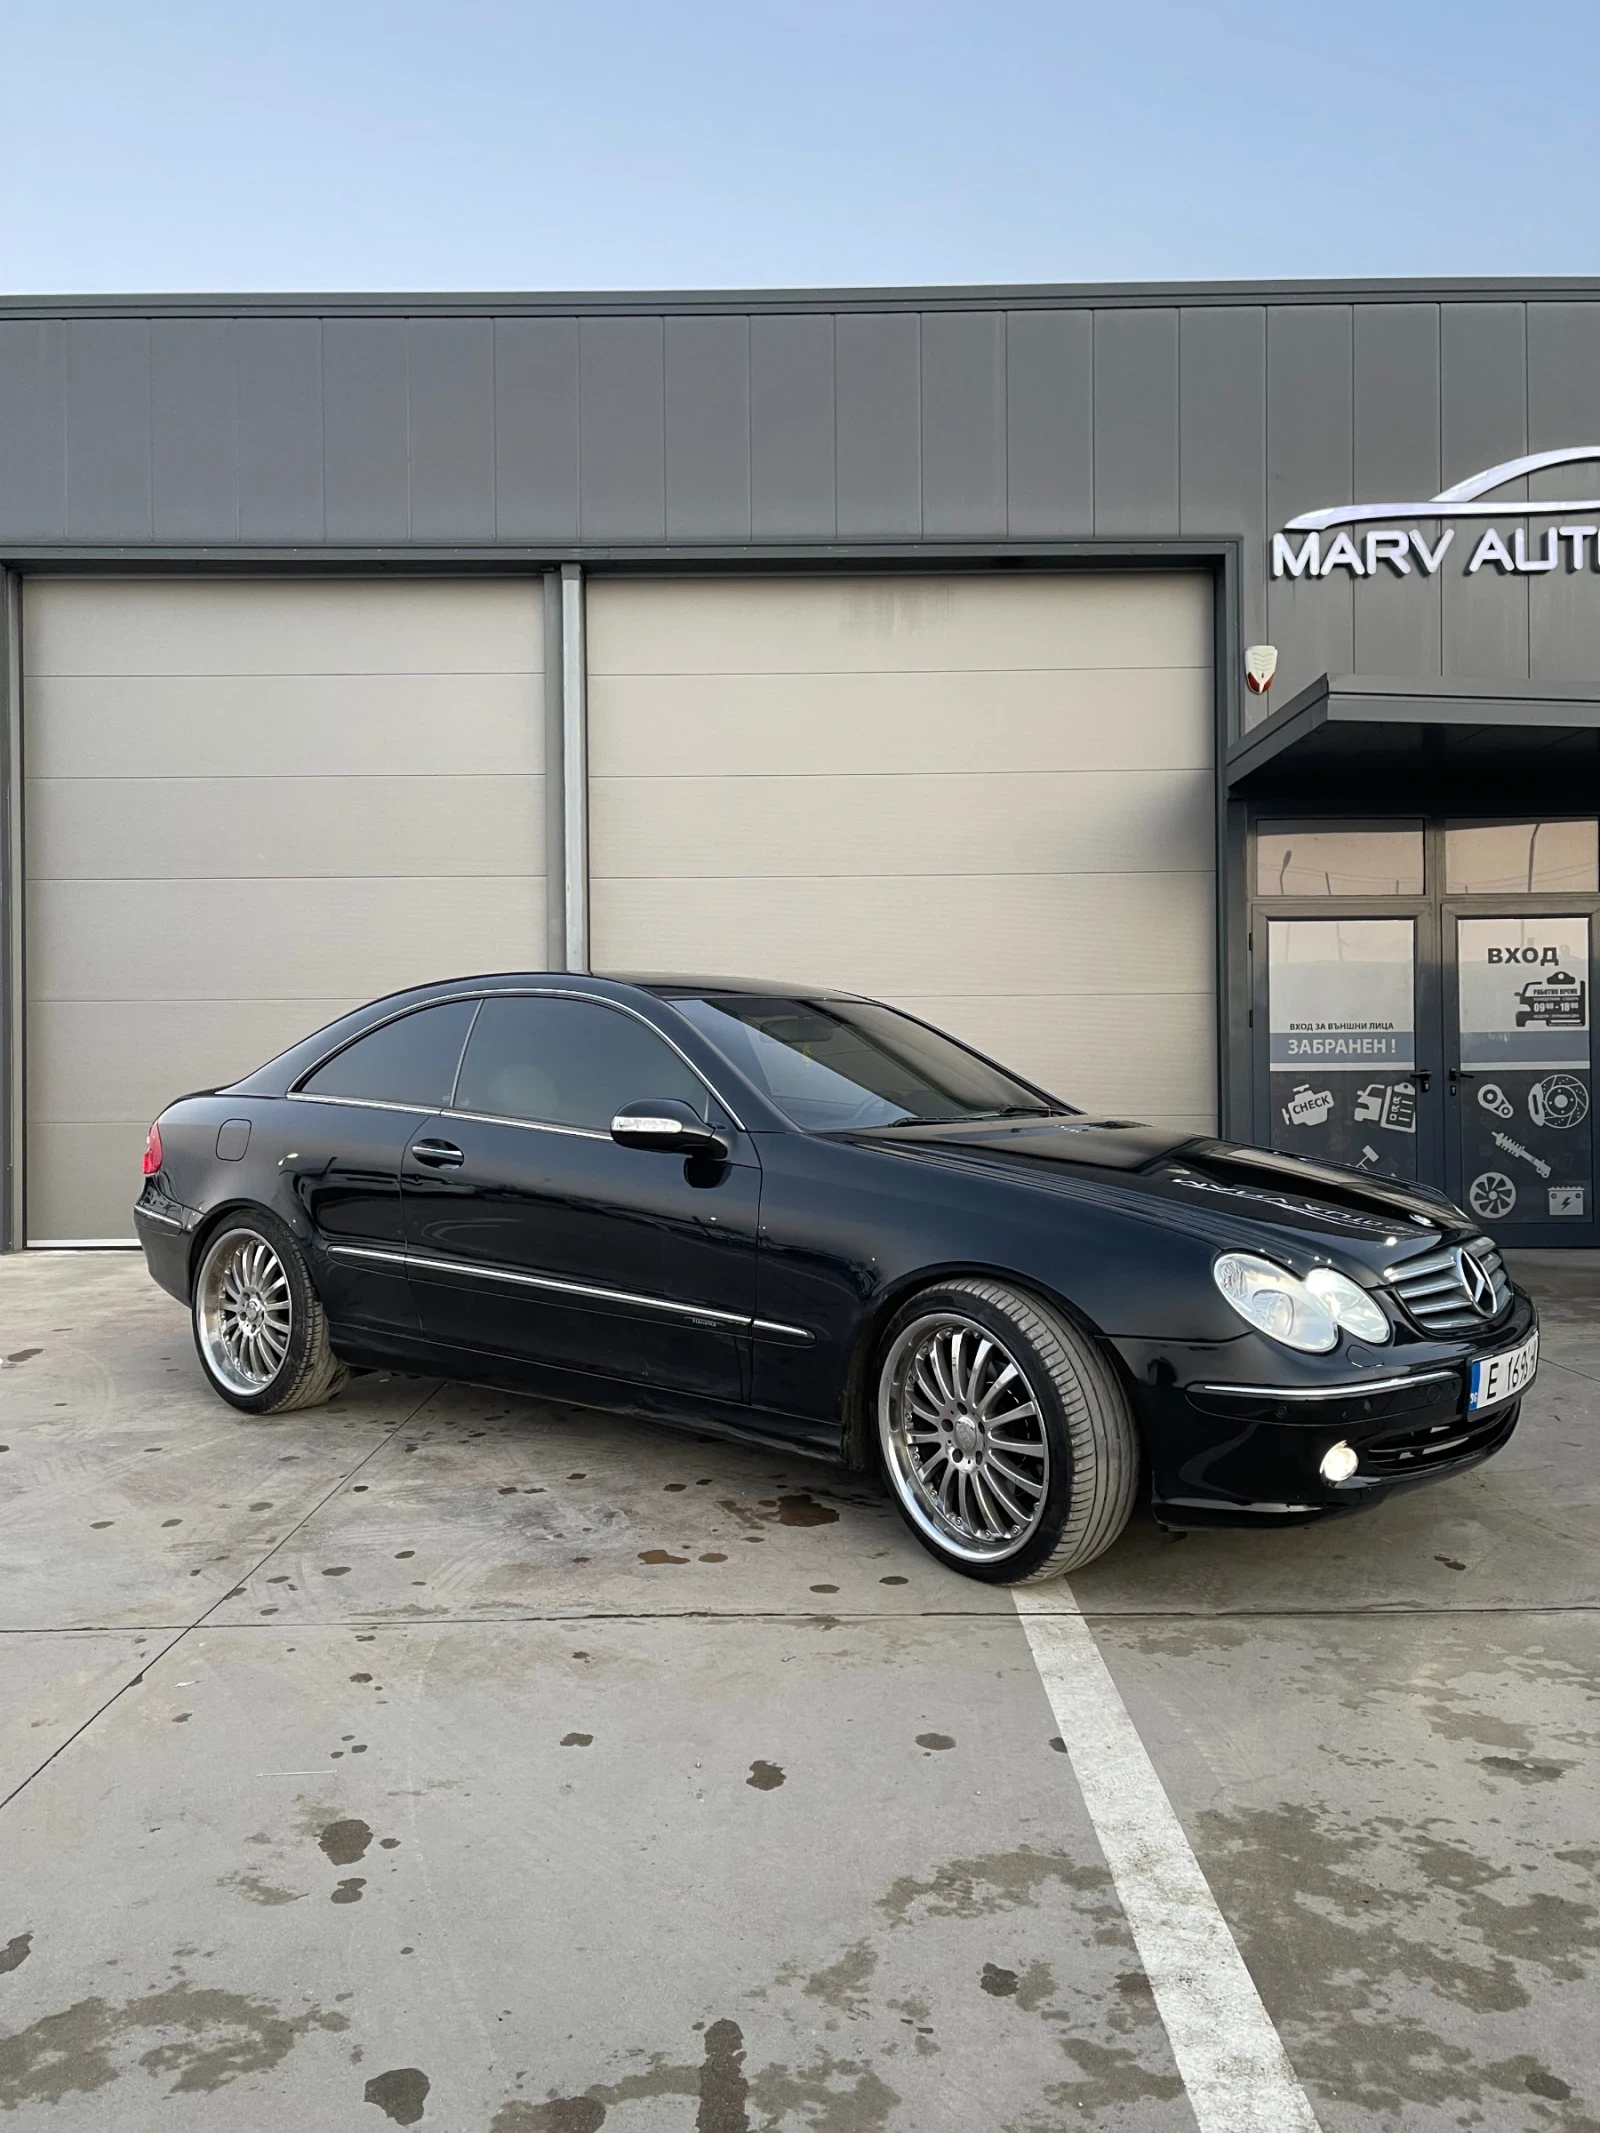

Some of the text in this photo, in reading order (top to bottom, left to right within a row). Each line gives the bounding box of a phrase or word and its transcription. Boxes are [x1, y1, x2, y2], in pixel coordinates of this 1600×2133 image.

[1272, 525, 1600, 577] MARV AUT
[1487, 947, 1559, 967] ВХОД
[1289, 1022, 1394, 1031] ВХОД ЗА ВЪНШНИ ЛИЦА
[1287, 1038, 1387, 1055] ЗАБРАНЕН
[1292, 1095, 1331, 1115] CHECK
[1487, 1363, 1499, 1399] E
